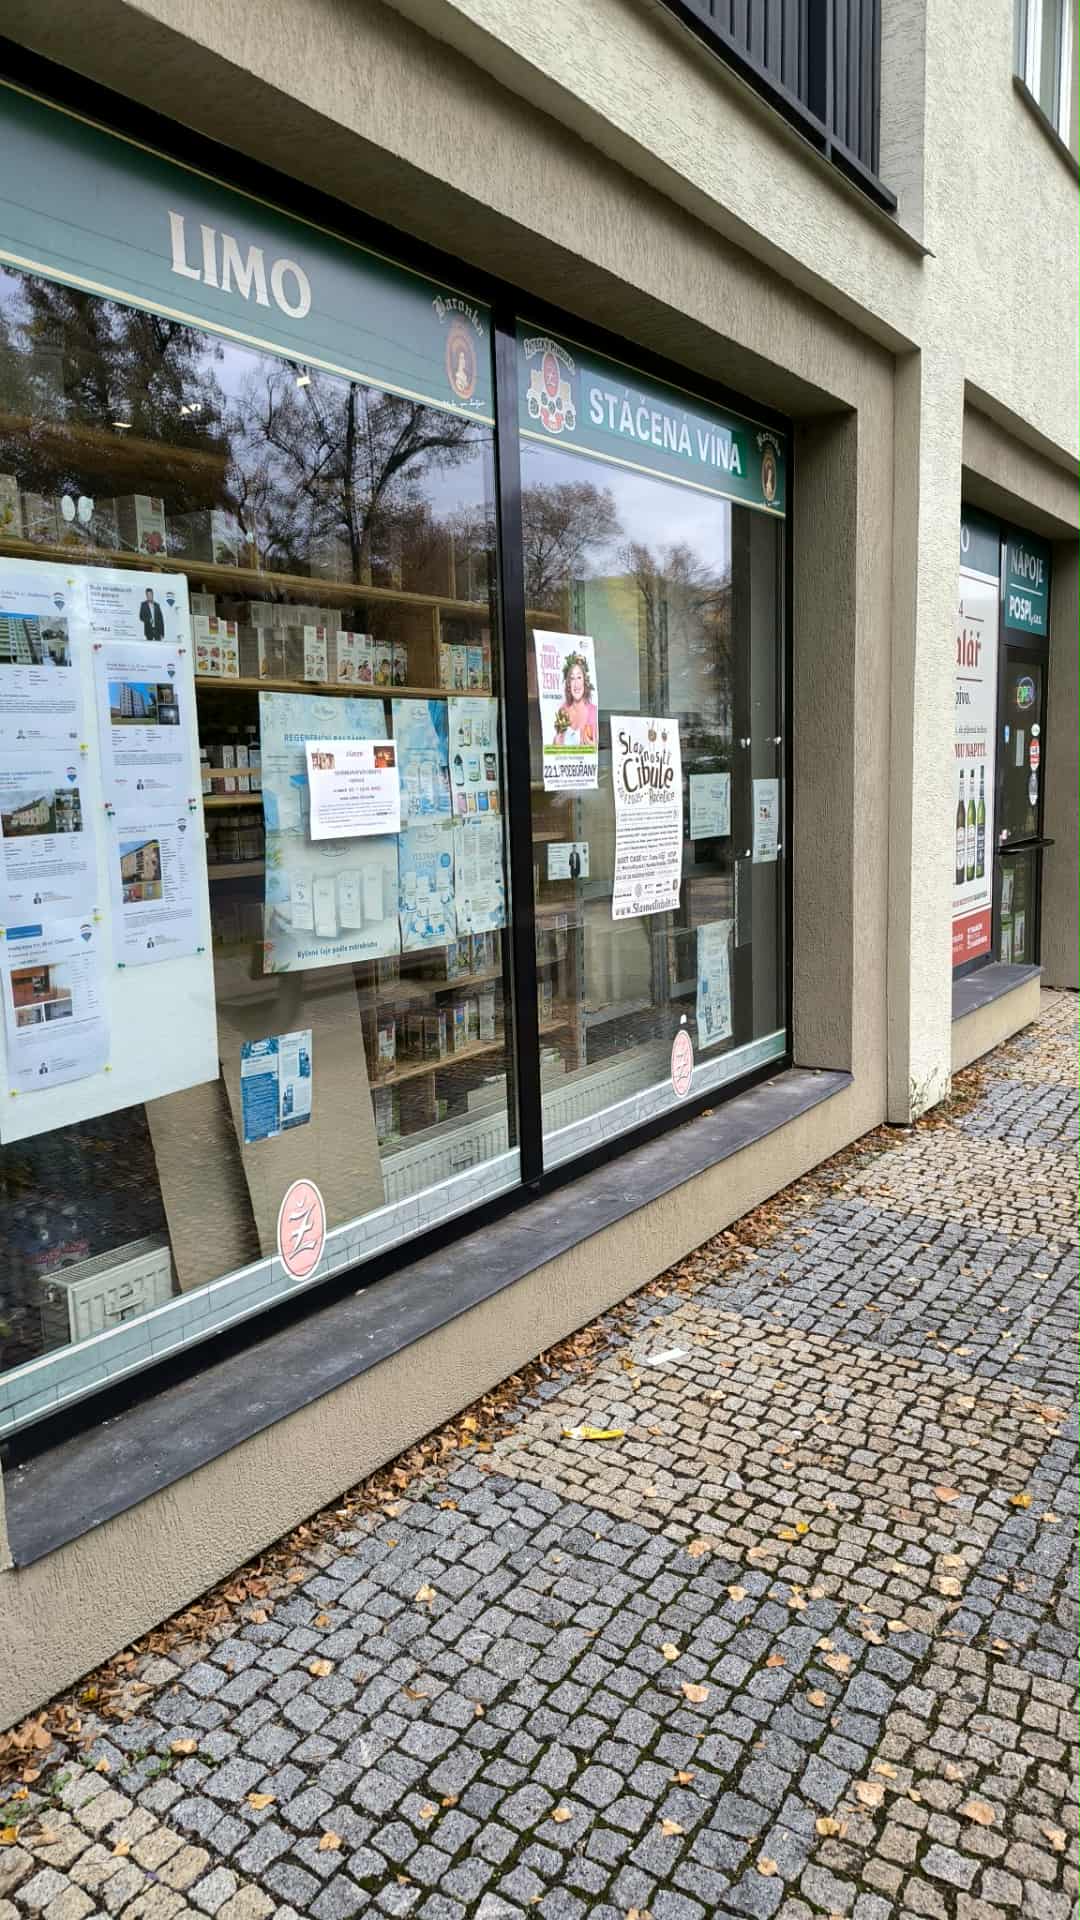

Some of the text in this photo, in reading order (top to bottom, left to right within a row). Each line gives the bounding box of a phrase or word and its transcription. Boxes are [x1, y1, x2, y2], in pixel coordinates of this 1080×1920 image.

[168, 210, 312, 319] LIMO
[589, 388, 742, 476] STÁČENÁ VÍNA
[1010, 544, 1044, 588] NÁPOJE
[618, 731, 672, 766] Slavnosti
[622, 754, 675, 793] Cibule
